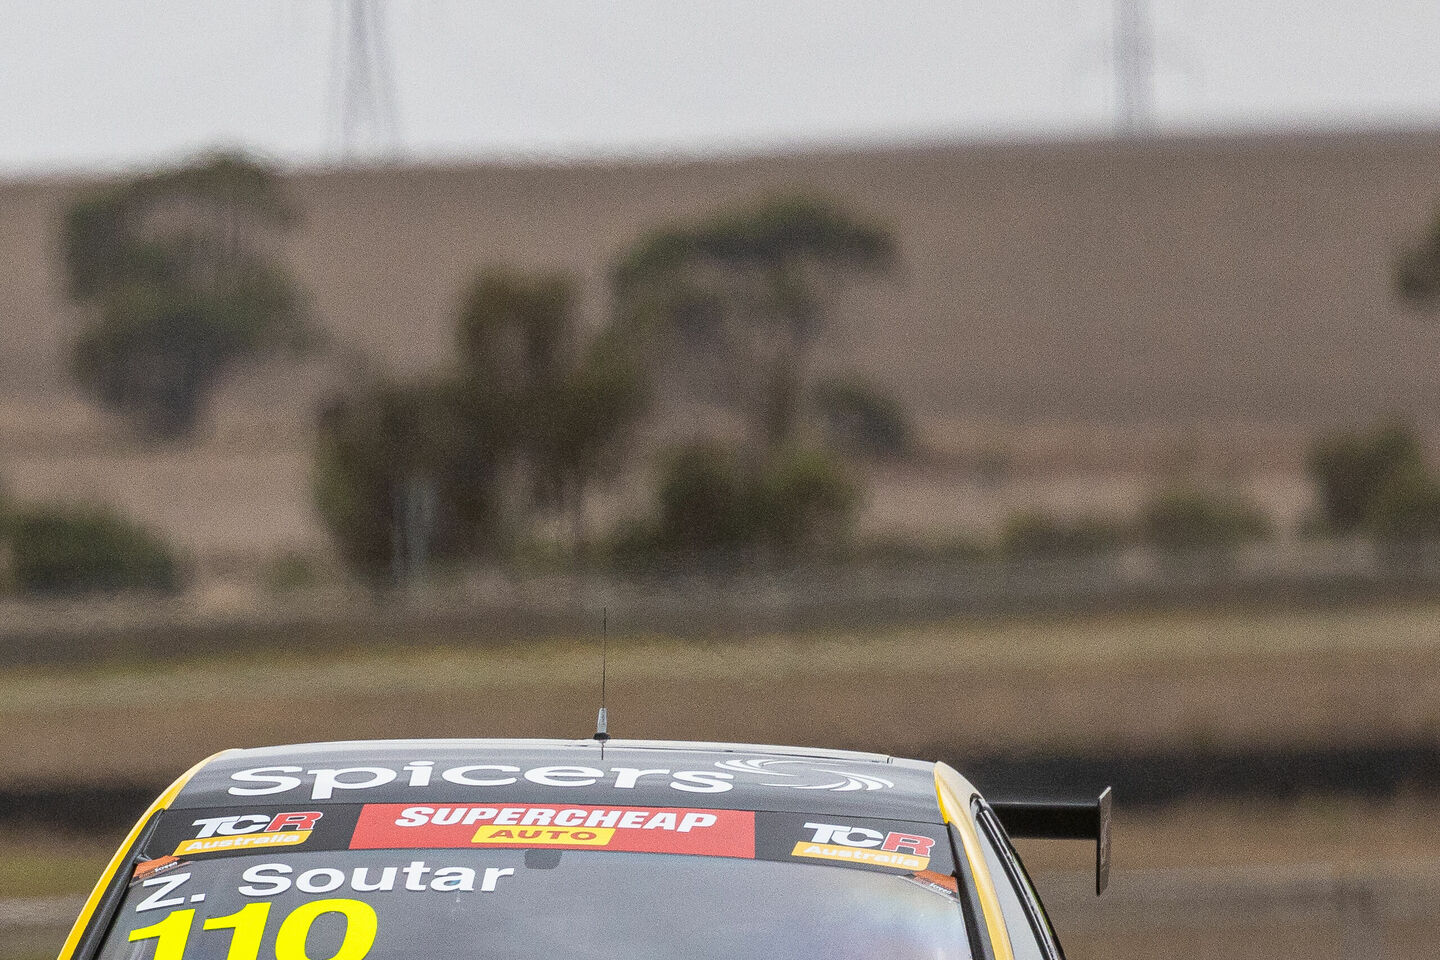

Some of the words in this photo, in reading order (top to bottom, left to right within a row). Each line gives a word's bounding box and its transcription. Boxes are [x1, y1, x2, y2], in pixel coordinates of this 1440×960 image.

[227, 760, 735, 800] Spicers
[192, 811, 324, 839] TCR
[395, 805, 718, 834] SUPERCHEAP
[185, 833, 301, 852] Australia
[488, 829, 598, 841] AUTO
[803, 822, 936, 858] TCR
[803, 845, 920, 868] Australia
[135, 872, 206, 913] Z.
[238, 861, 515, 898] Soutar
